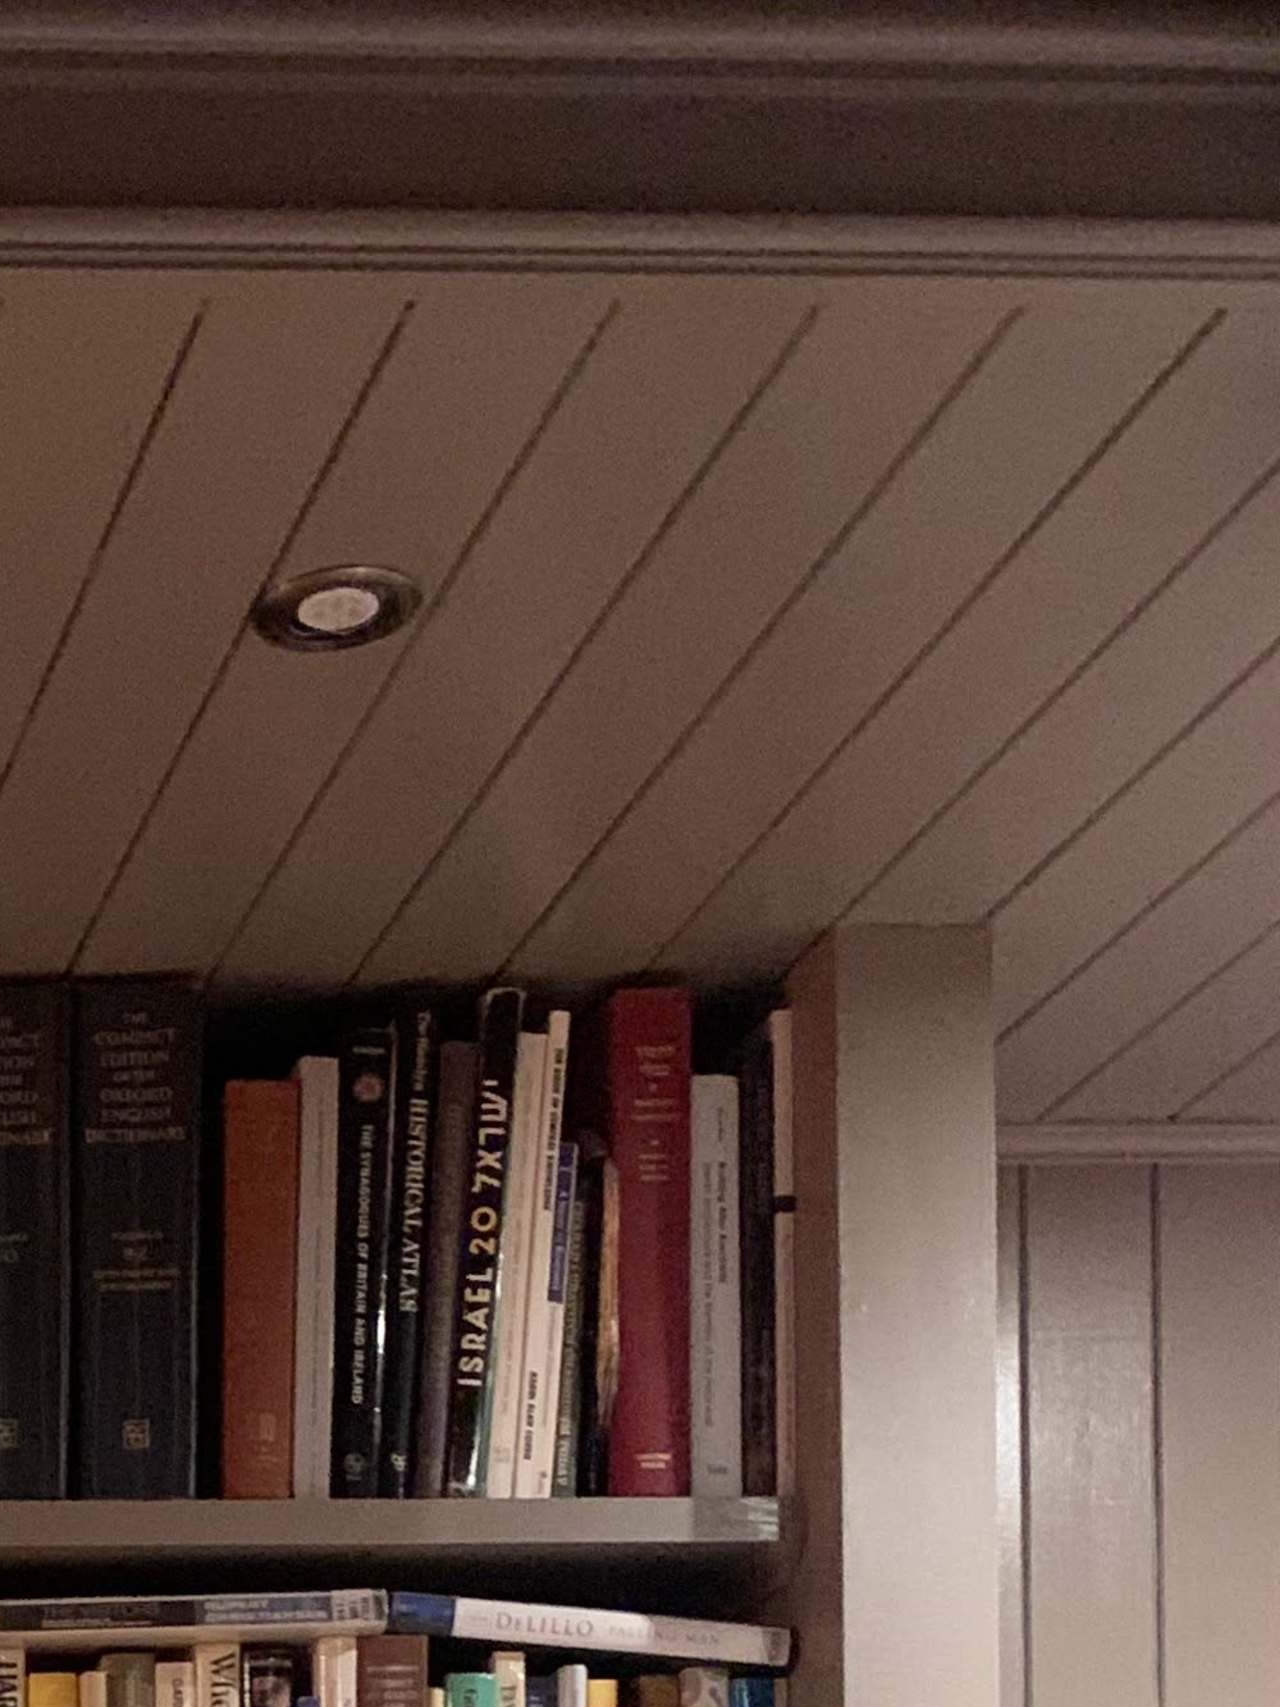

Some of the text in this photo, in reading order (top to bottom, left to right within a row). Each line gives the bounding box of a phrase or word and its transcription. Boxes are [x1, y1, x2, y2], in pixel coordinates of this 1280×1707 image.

[100, 1108, 168, 1123] ENGLISH
[402, 1098, 431, 1233] HISTORICAL
[352, 1124, 375, 1405] THE SYNAGOGUES OF BRITAIN AND IRELAND
[398, 1237, 424, 1313] ATLAS
[455, 1206, 500, 1386] ISRAEL 20
